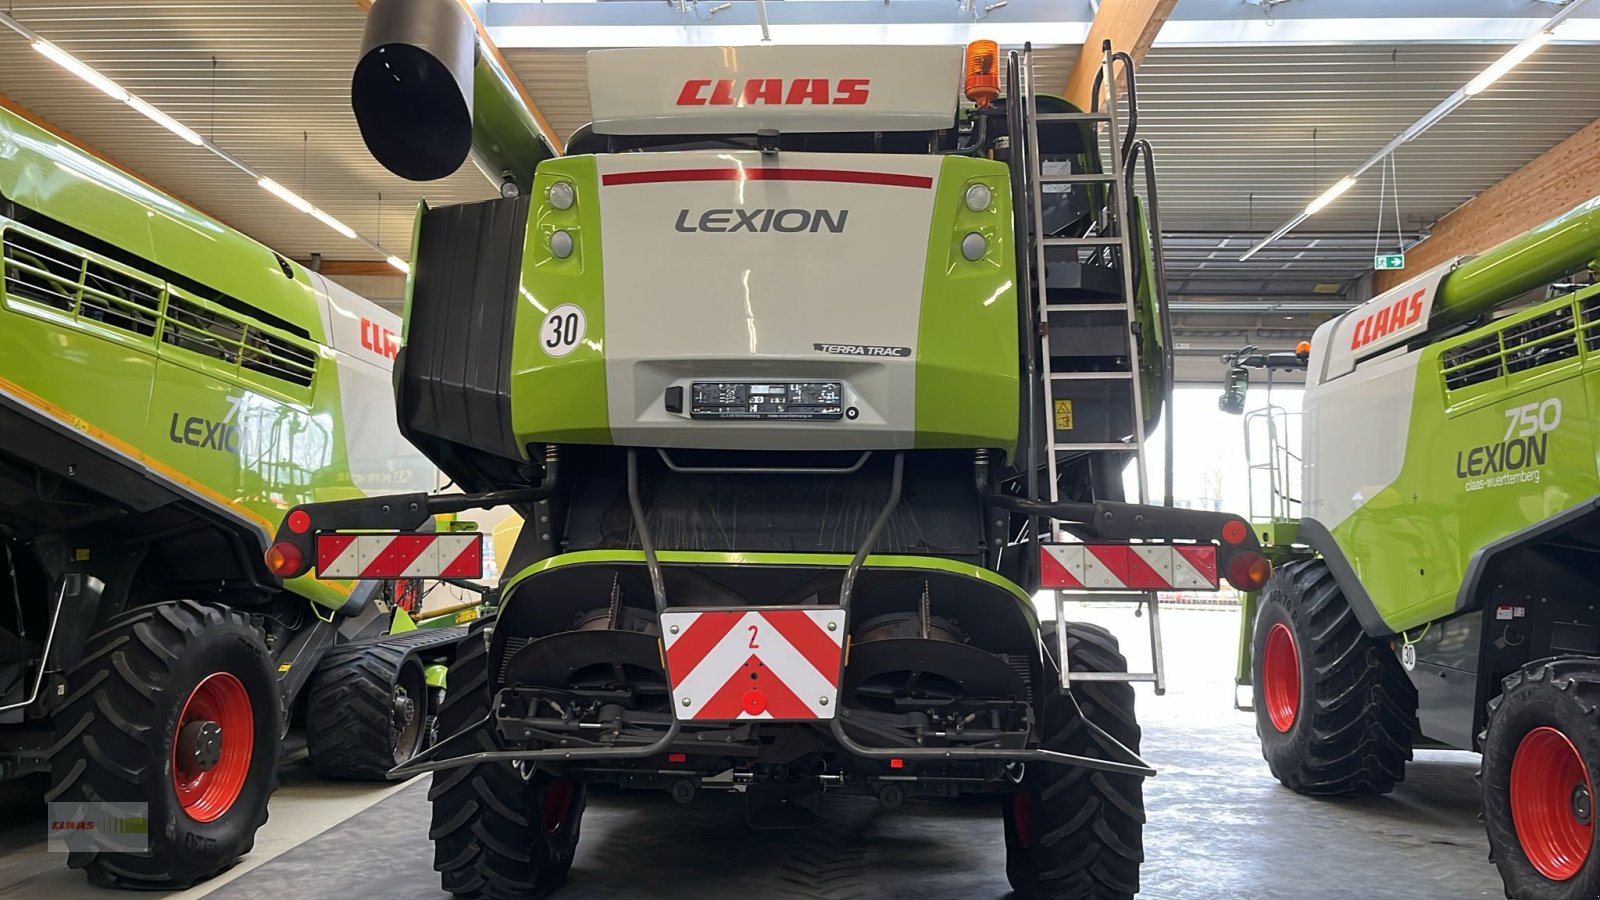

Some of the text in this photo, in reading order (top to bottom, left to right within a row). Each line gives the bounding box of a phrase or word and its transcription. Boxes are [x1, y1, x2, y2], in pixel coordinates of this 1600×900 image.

[676, 79, 870, 105] CLAAS
[675, 209, 849, 233] LEXION
[546, 313, 578, 348] 30
[1351, 288, 1426, 350] CLAAS
[361, 317, 398, 361] CLA
[821, 344, 902, 356] TERRA TRAC
[1504, 398, 1562, 441] 750
[1457, 433, 1547, 478] LEXION
[748, 625, 759, 648] 2
[1403, 646, 1414, 665] 30
